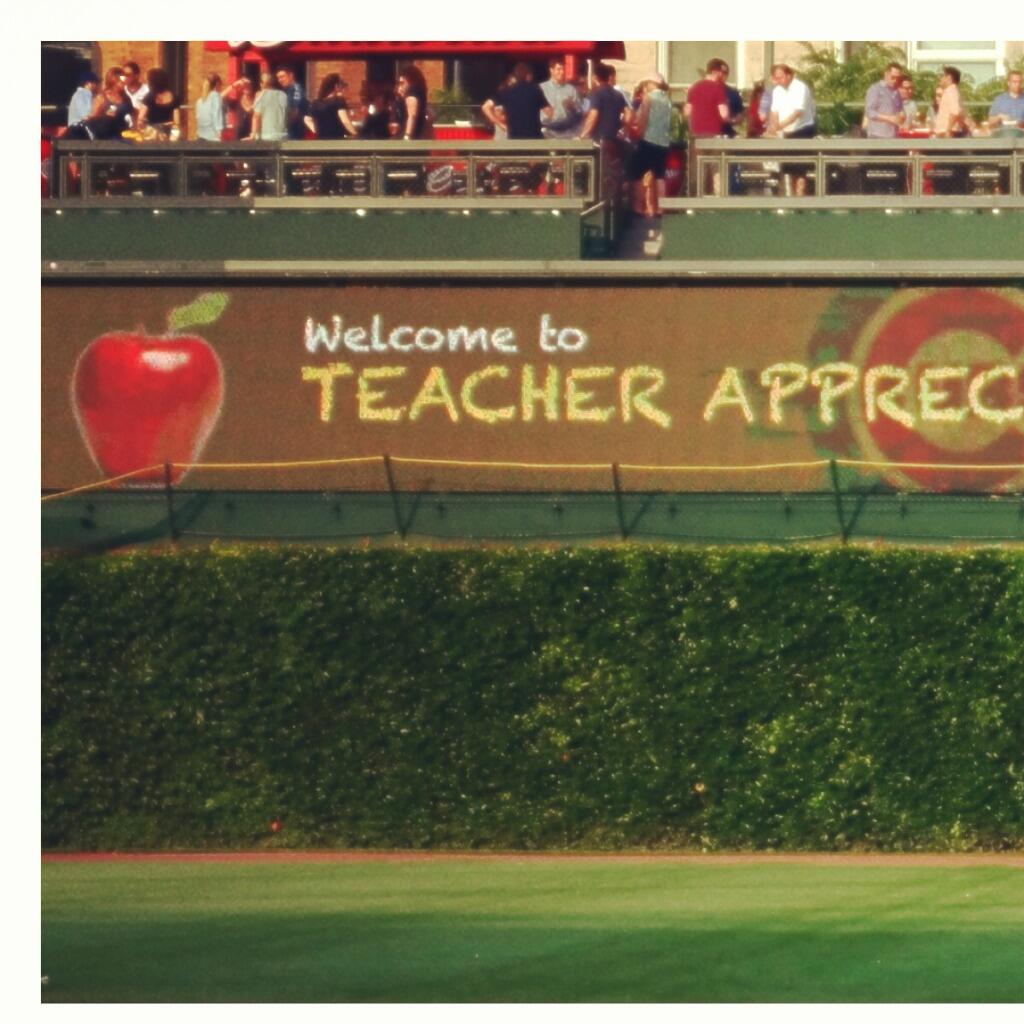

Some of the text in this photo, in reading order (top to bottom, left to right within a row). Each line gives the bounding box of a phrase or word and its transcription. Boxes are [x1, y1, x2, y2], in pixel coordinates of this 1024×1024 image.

[303, 313, 588, 352] Welcome to
[301, 361, 671, 429] TEACHER
